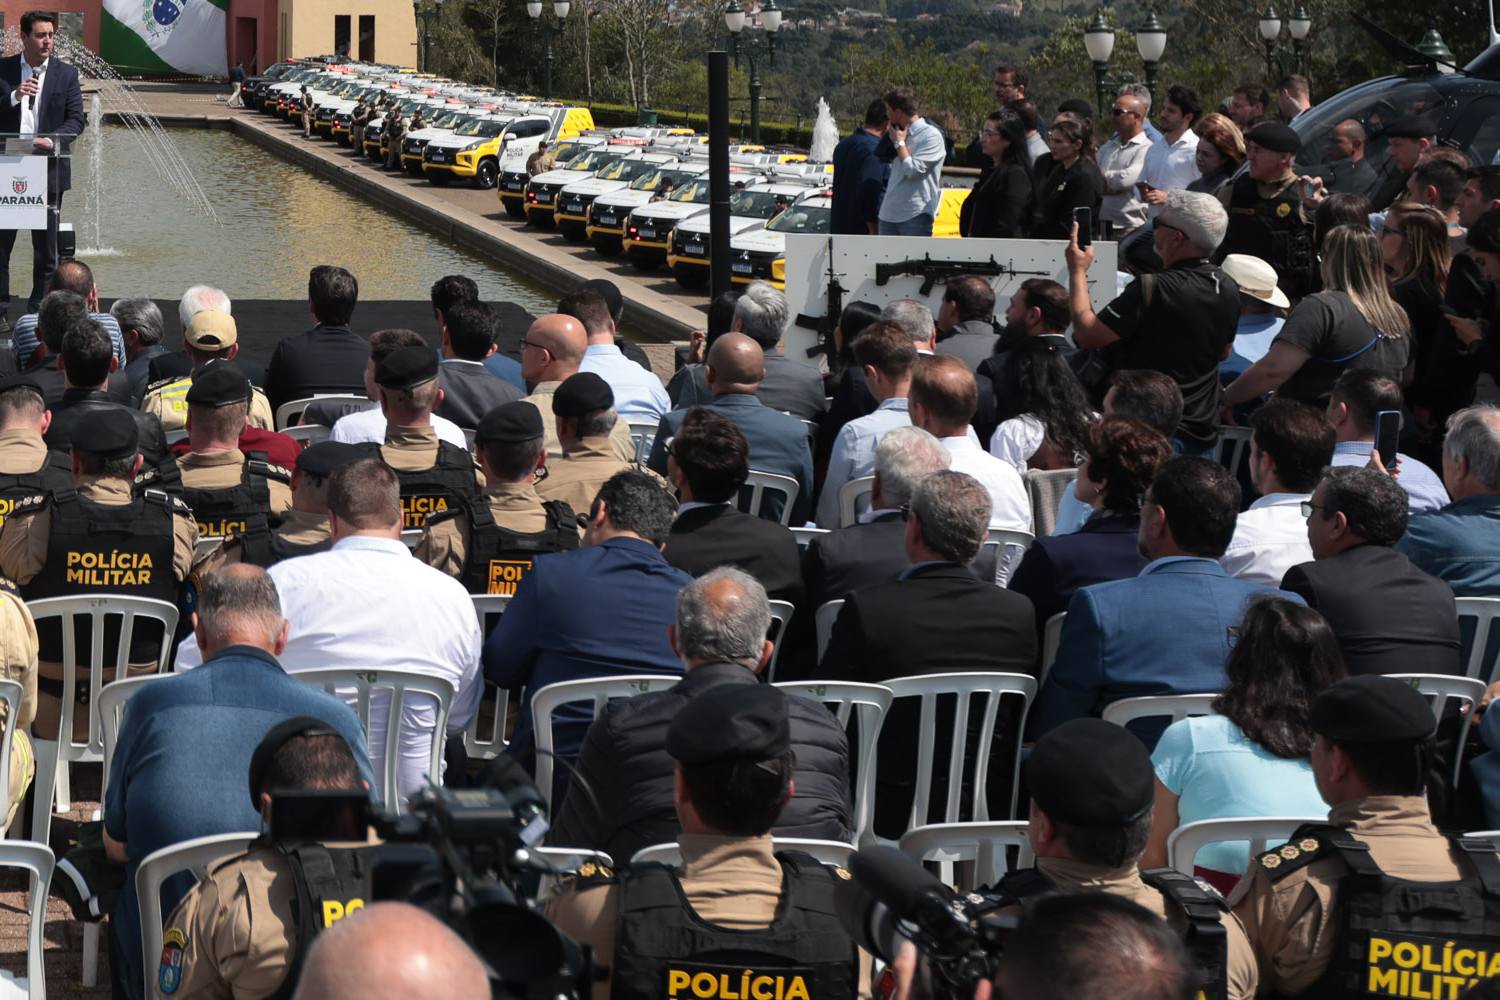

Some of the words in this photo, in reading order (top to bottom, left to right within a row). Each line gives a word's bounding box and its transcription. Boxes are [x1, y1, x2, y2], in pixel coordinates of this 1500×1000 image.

[399, 496, 448, 513] LÍCIA
[197, 519, 246, 537] OLÍCI
[67, 549, 152, 569] POLÍCIA
[66, 570, 150, 585] MILITAR
[668, 969, 811, 1000] POLÍCIA
[1368, 966, 1479, 1000] MILIT
